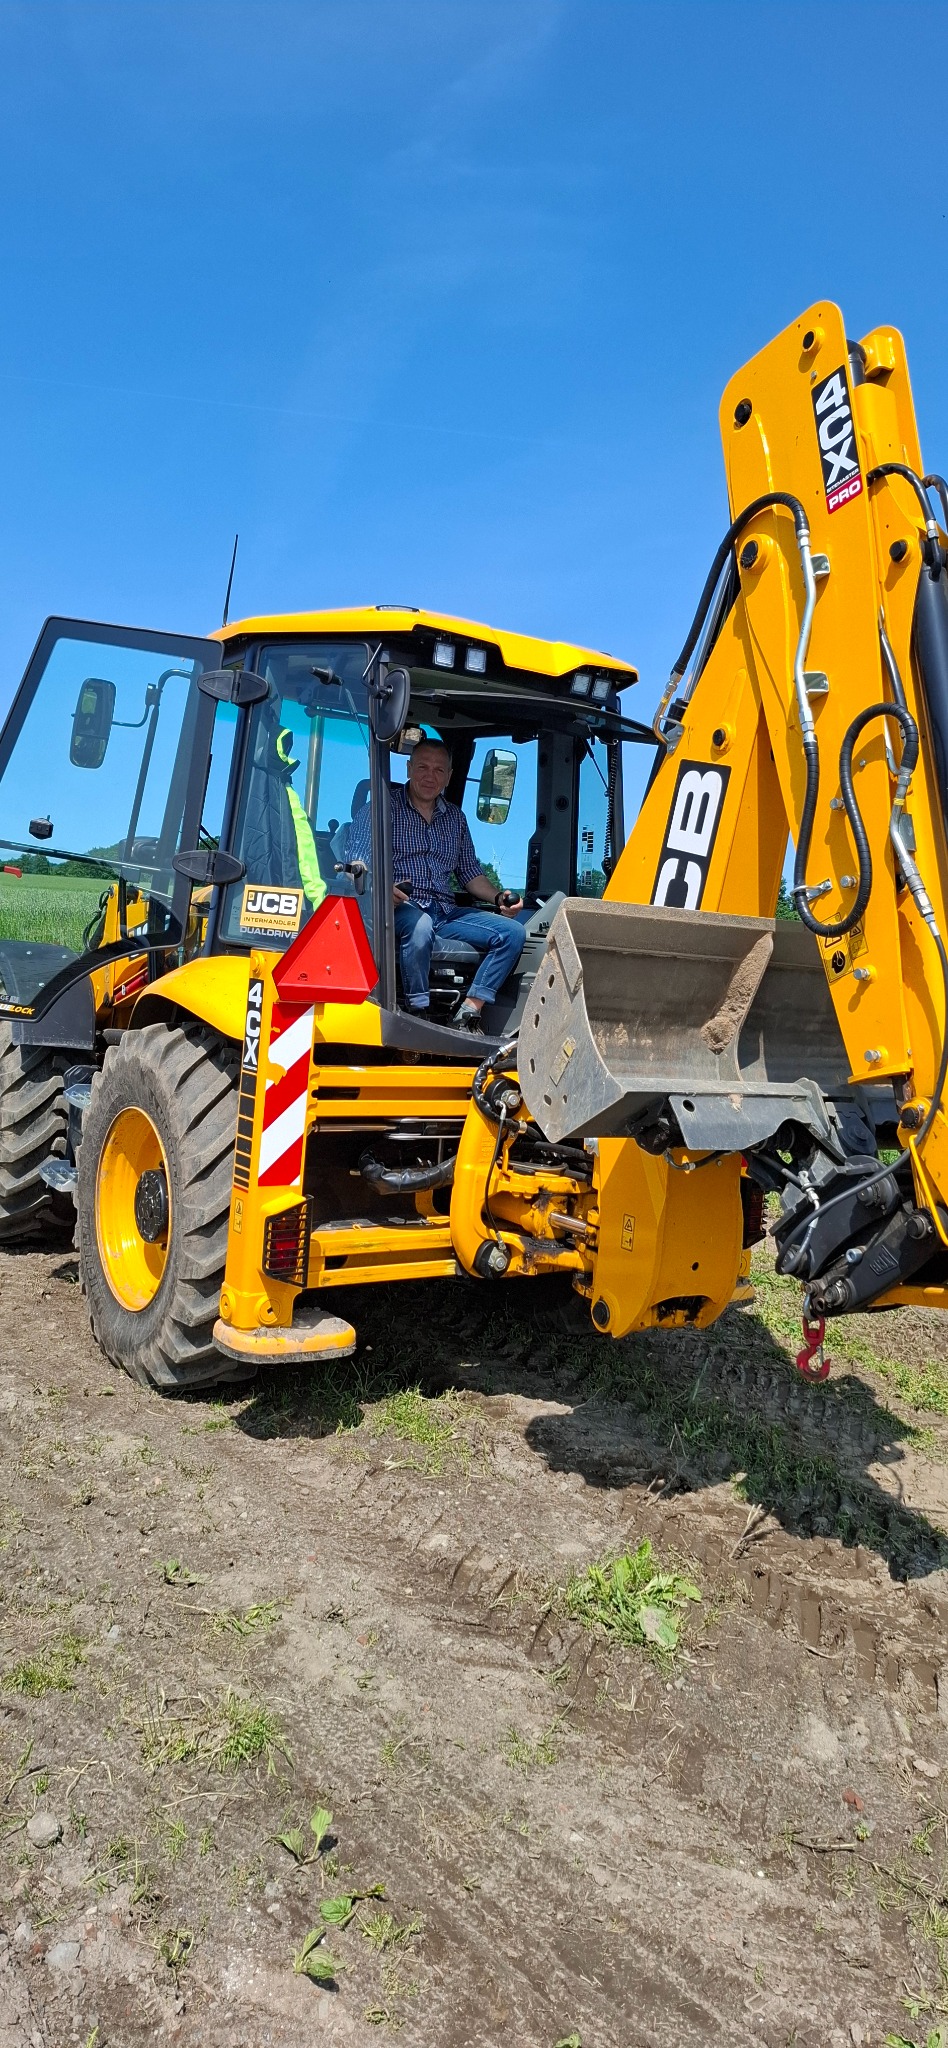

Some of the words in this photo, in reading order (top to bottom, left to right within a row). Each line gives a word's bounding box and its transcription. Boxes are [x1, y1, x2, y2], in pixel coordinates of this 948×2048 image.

[815, 372, 858, 487] 4CX
[828, 480, 861, 510] PRO
[653, 770, 723, 911] CB
[247, 892, 298, 915] JCB
[240, 926, 299, 939] DUALDRIVE
[243, 916, 297, 927] INTERHANDLER
[243, 982, 262, 1066] 4CX
